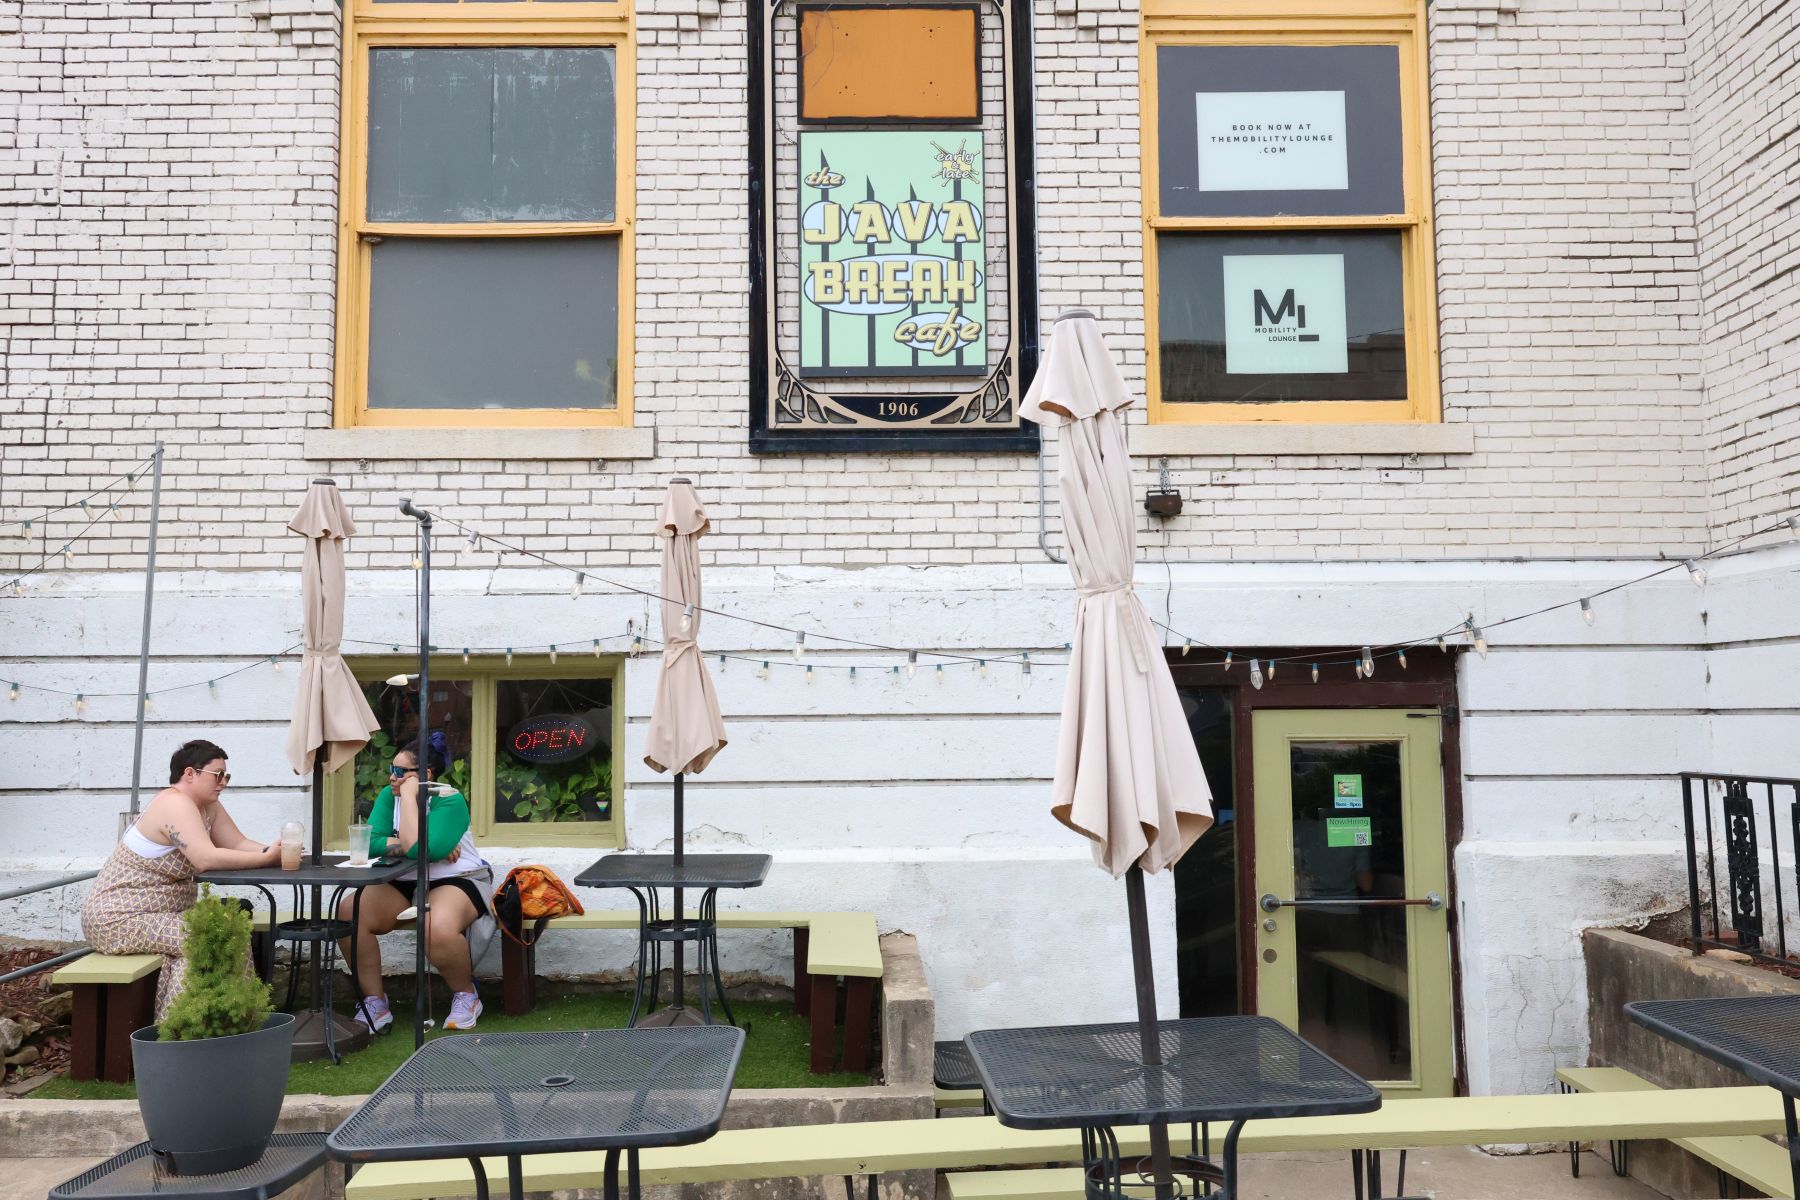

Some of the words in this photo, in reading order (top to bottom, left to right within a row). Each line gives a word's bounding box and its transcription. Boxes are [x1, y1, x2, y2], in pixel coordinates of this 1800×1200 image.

[1211, 134, 1333, 142] THEMOBILITYLOUNGE
[936, 150, 974, 164] early
[1259, 146, 1286, 154] .COM
[951, 160, 960, 169] &
[806, 167, 843, 187] the
[942, 167, 970, 179] late
[803, 202, 981, 244] JAVA
[808, 260, 977, 304] BREAK
[894, 307, 982, 357] cafe
[878, 402, 919, 416] 1906
[515, 728, 586, 750] OPEN
[1348, 818, 1369, 826] Hiring
